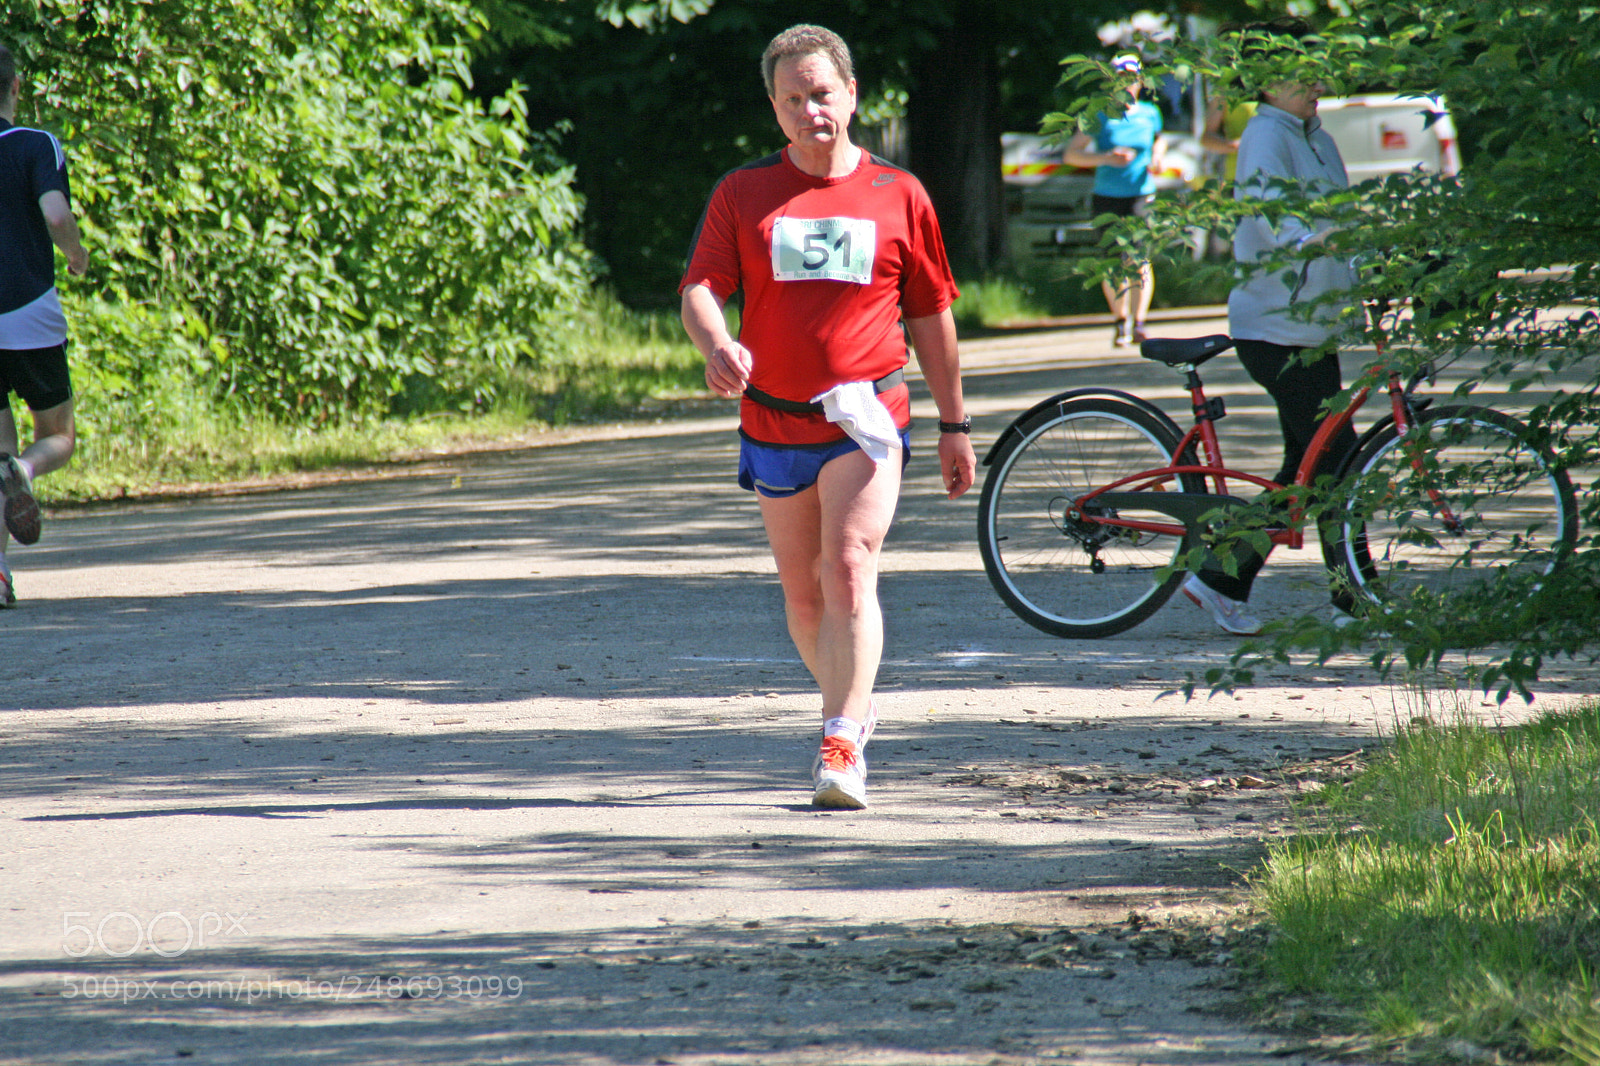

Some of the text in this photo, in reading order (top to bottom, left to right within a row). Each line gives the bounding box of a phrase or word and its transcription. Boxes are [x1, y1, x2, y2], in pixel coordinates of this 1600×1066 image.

[803, 230, 852, 271] 51
[794, 270, 807, 279] Run
[809, 271, 821, 279] and
